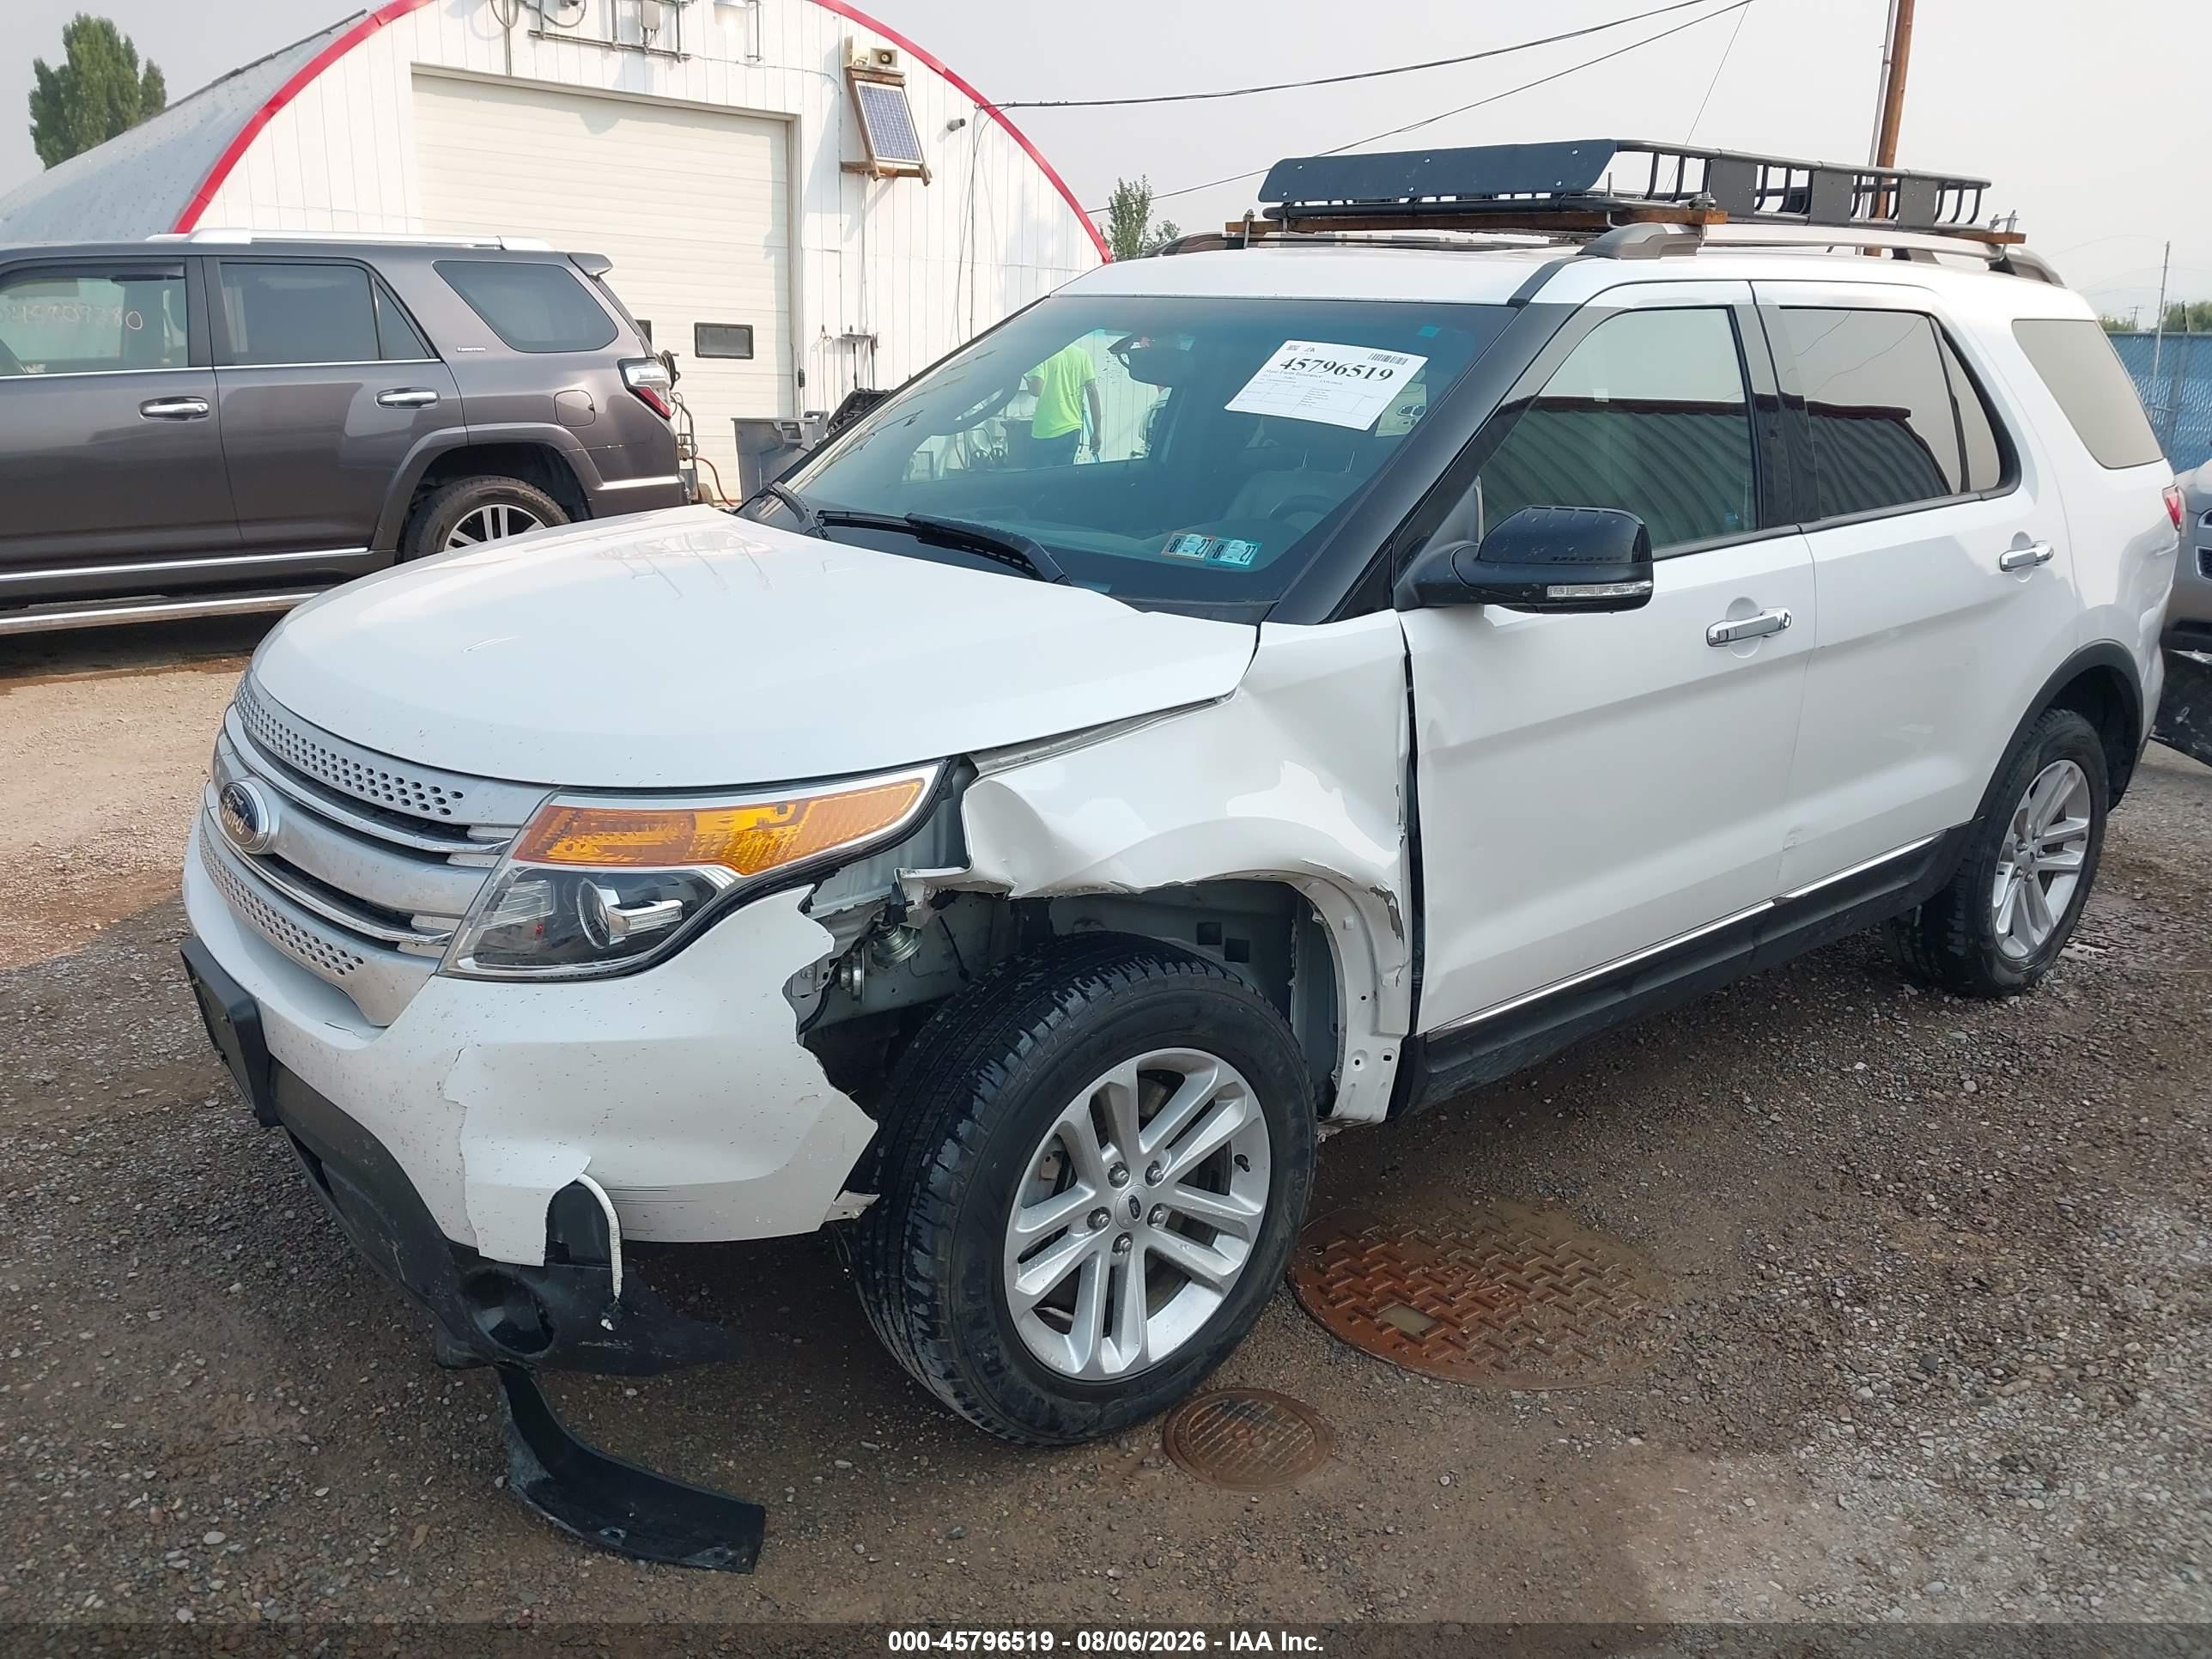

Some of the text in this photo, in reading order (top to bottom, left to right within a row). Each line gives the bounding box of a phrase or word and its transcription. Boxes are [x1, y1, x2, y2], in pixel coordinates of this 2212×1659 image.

[1279, 356, 1395, 381] 45796519
[1169, 538, 1213, 557] 8 27
[1212, 544, 1256, 564] 8 27
